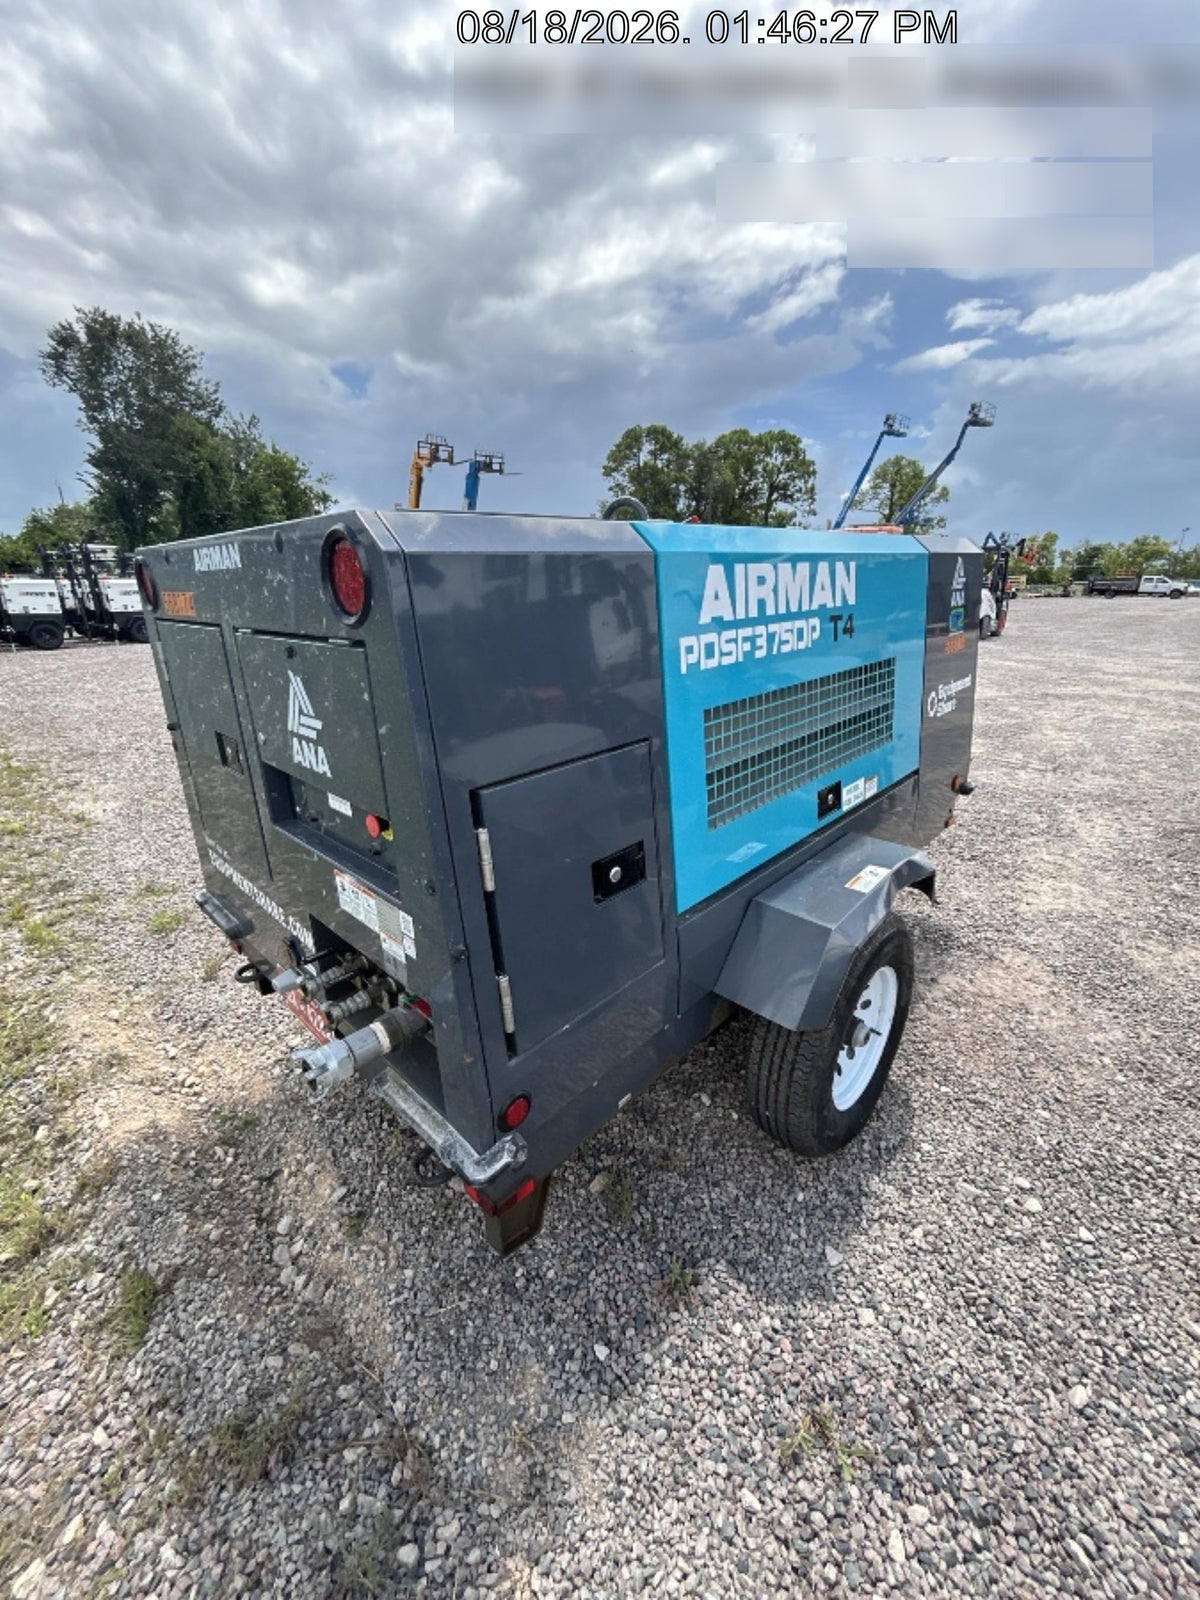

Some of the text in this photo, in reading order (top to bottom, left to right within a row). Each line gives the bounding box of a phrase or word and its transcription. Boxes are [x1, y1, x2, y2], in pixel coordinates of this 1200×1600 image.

[193, 542, 242, 571] AIRMAN
[698, 561, 857, 625] AIRMAN
[679, 613, 855, 674] PDSF375DP T4
[293, 737, 332, 778] ANA
